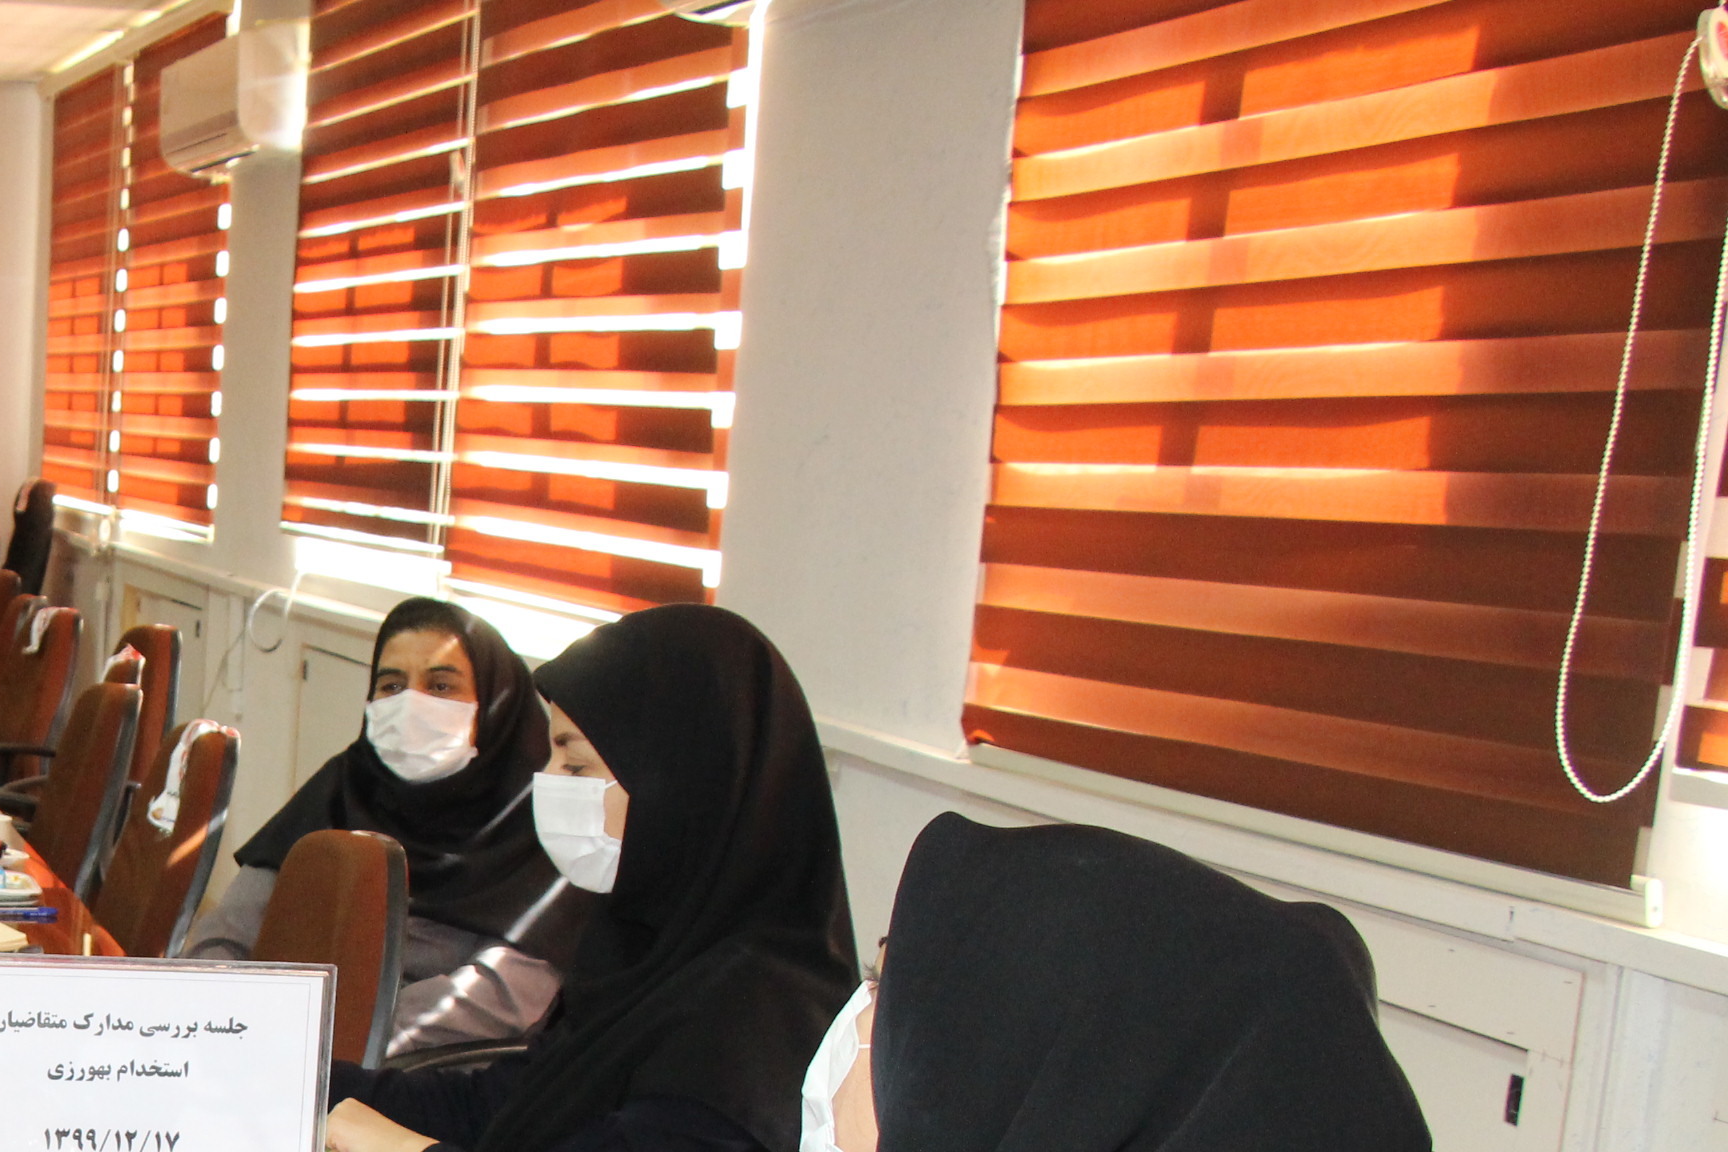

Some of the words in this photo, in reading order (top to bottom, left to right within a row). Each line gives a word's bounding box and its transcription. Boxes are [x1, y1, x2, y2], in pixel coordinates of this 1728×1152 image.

[72, 1012, 134, 1036] مدارک
[139, 1019, 198, 1038] بررسی
[203, 1017, 248, 1039] جلسه
[46, 1061, 112, 1082] بهورزی
[116, 1059, 189, 1082] استخدام
